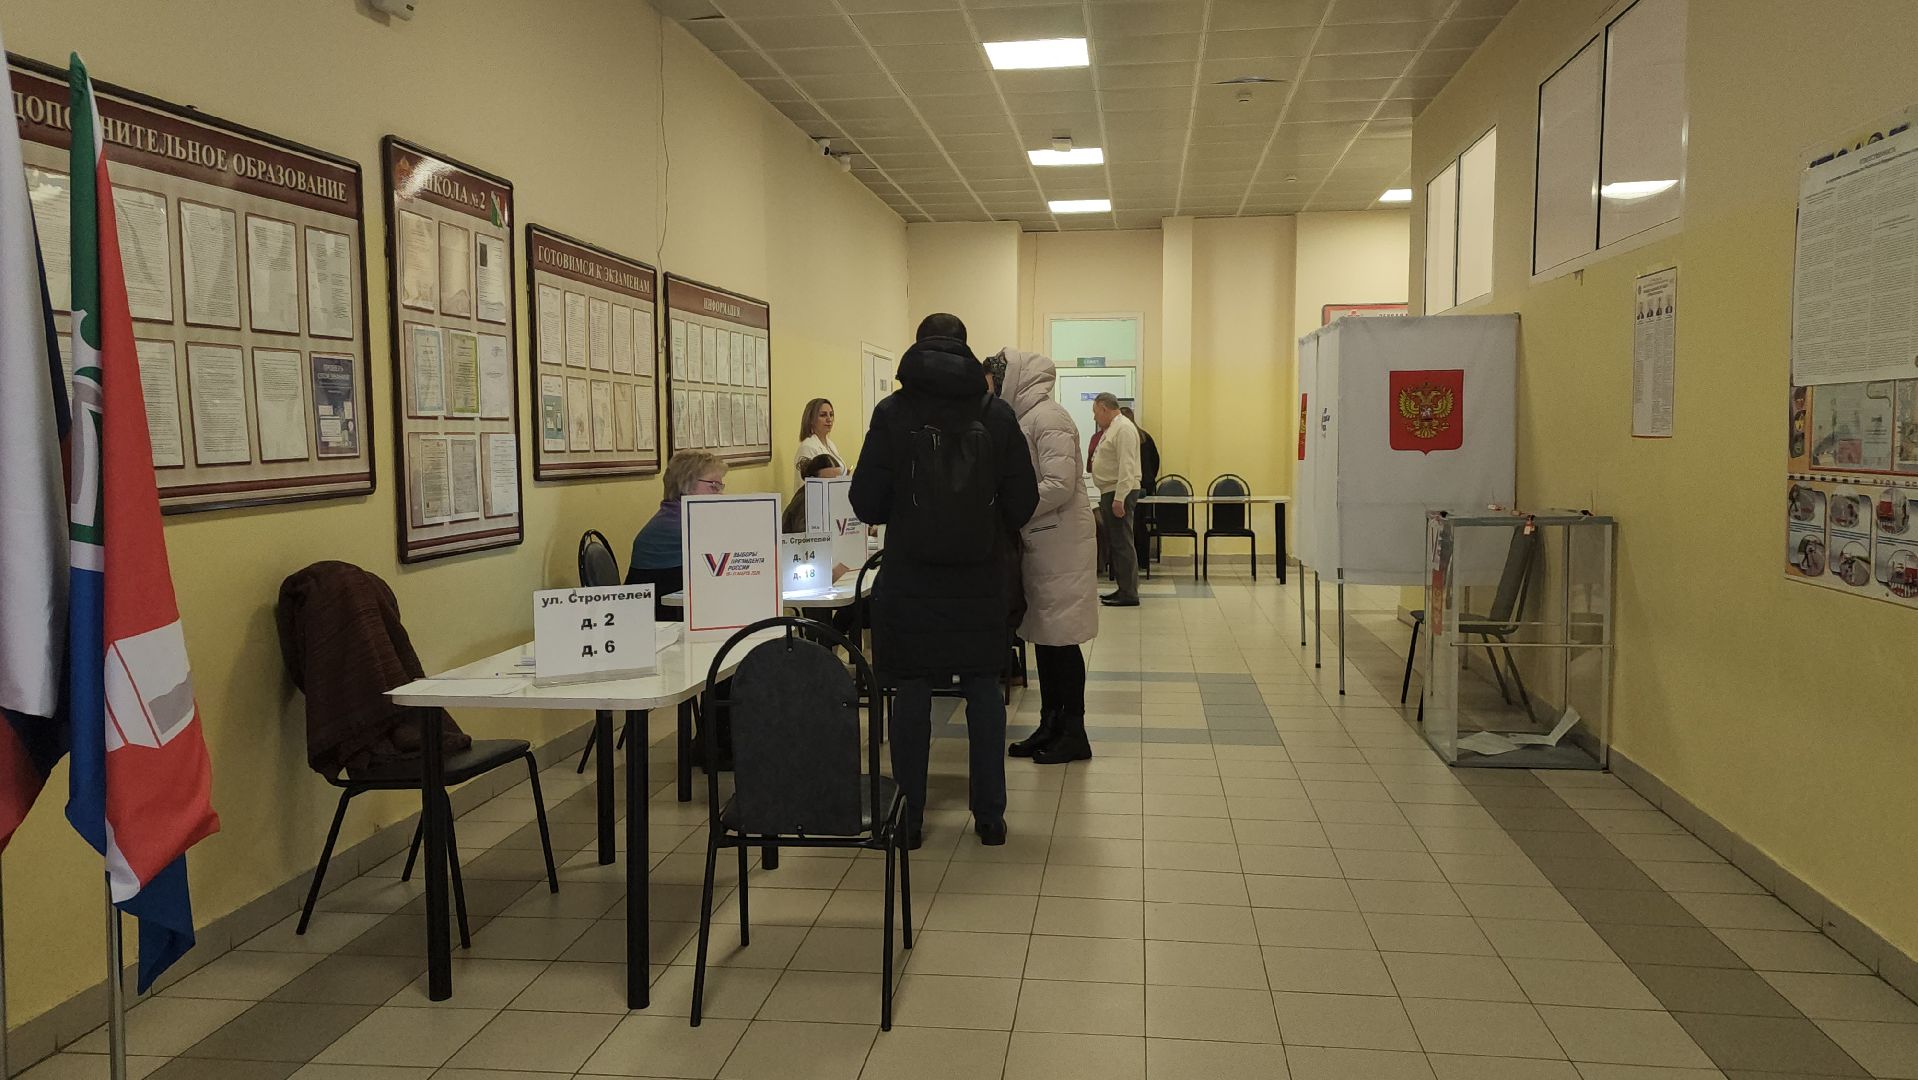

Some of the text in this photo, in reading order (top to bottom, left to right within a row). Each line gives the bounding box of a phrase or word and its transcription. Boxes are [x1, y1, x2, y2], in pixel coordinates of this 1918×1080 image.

[11, 90, 348, 202] ДОПНИТЕЛЬНОЕ ОБРАЗОВАНИЕ
[480, 191, 486, 209] 2
[538, 245, 650, 293] ГОТОВИМСЯ К ЭКЗАМЕНАМ
[792, 550, 815, 563] д. 14
[792, 568, 816, 581] д. 18
[541, 588, 652, 608] ул. Строителей
[580, 612, 615, 630] д. 2
[581, 640, 616, 657] д. 6
